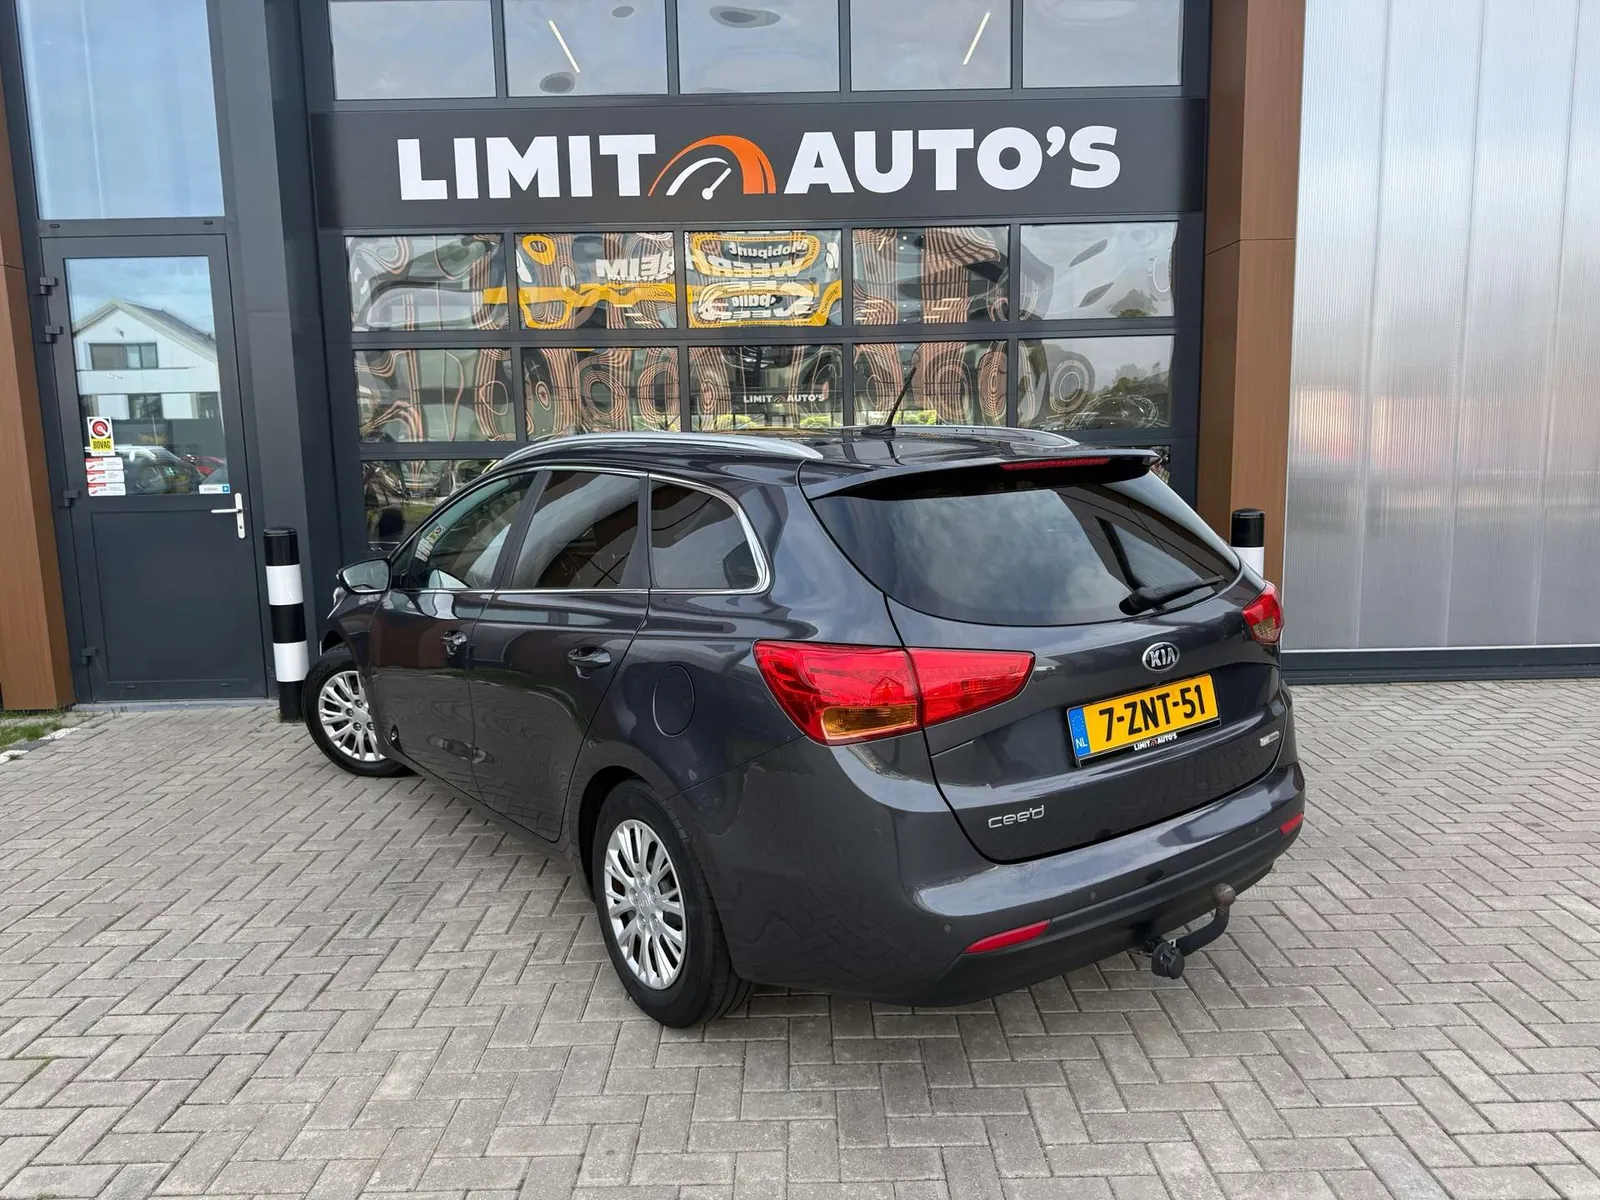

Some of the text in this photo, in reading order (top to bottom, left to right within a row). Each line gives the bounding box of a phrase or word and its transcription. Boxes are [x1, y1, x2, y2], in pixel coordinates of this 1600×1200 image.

[397, 125, 1121, 200] LIMIT AUTO'S
[743, 394, 825, 403] LIMIT AUTO'S
[1149, 647, 1177, 668] KIA
[1075, 684, 1206, 749] NL 7-ZNT-51
